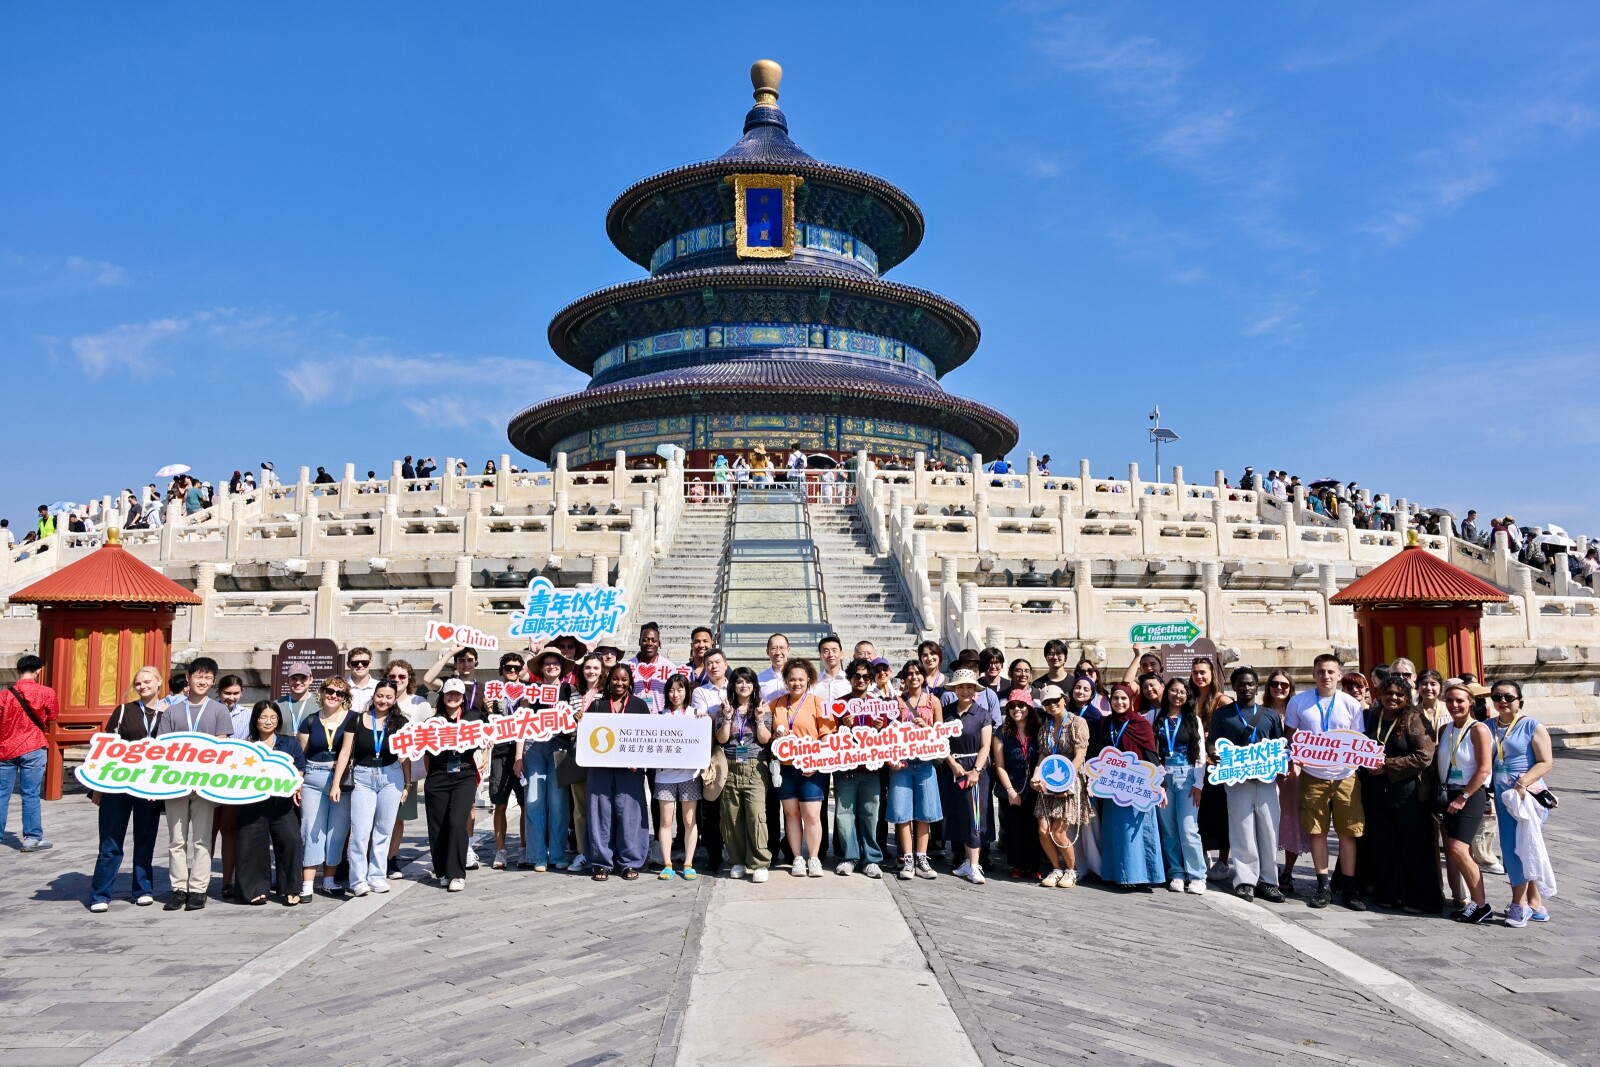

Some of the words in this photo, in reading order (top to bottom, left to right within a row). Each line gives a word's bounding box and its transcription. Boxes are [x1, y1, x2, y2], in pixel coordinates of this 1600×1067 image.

[528, 589, 618, 617] 青年伙伴
[429, 624, 434, 639] I
[455, 628, 496, 647] China
[521, 611, 618, 637] 国际交流计划
[1142, 624, 1189, 636] Together
[1134, 634, 1146, 642] for
[1148, 633, 1188, 642] Tomorrow
[486, 682, 503, 699] 我
[526, 687, 558, 703] 中国
[823, 703, 828, 715] I
[853, 701, 899, 716] Beijing
[392, 723, 482, 754] 中美青年
[496, 708, 577, 740] 亚太同心
[635, 729, 658, 737] TENG
[855, 728, 898, 748] Youth
[899, 727, 932, 743] Tour
[935, 723, 951, 739] for
[952, 725, 960, 735] a
[91, 737, 233, 765] Together
[803, 752, 842, 769] Shared
[843, 746, 907, 764] Asia-Pacific
[909, 743, 945, 757] Future
[1106, 757, 1128, 768] 2026
[1219, 742, 1282, 767] 青年伙伴
[1292, 745, 1339, 762] Youth
[97, 761, 146, 782] for
[148, 764, 299, 794] Tomorrow
[1110, 770, 1145, 785] 中美青年
[1218, 758, 1287, 781] 国际交流计划
[1099, 776, 1152, 799] 亚太同心之旅
